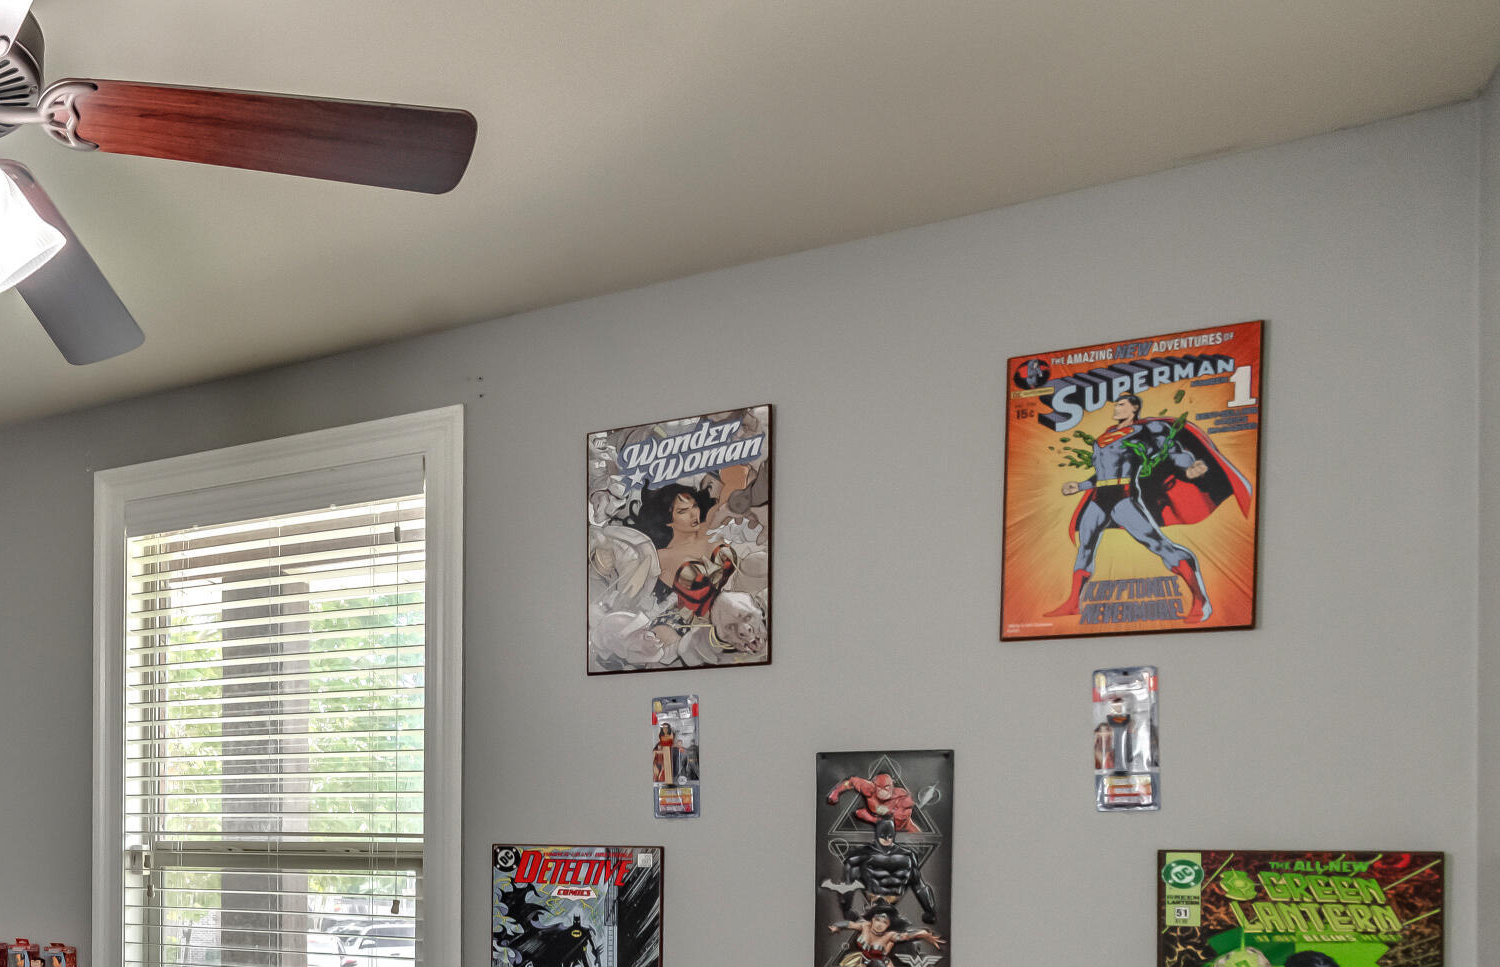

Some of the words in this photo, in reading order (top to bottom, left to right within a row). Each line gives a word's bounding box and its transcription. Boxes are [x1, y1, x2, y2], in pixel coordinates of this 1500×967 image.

[1051, 357, 1066, 365] THE
[1067, 348, 1113, 365] AMAZING
[1114, 341, 1153, 359] NEW
[1152, 332, 1222, 353] ADVENTURES
[1223, 332, 1234, 341] OF
[1051, 358, 1235, 432] SUPERMAN
[1228, 365, 1257, 408] 1
[622, 420, 742, 469] Wonder
[649, 435, 764, 484] Woman
[499, 850, 514, 866] DC
[514, 849, 634, 887] DETECTIVE
[1173, 866, 1193, 881] DC
[1269, 861, 1291, 870] THE
[556, 888, 591, 897] COMICS
[1257, 871, 1387, 905] GREEN
[1176, 908, 1189, 918] 51
[1228, 899, 1402, 933] LANTERN
